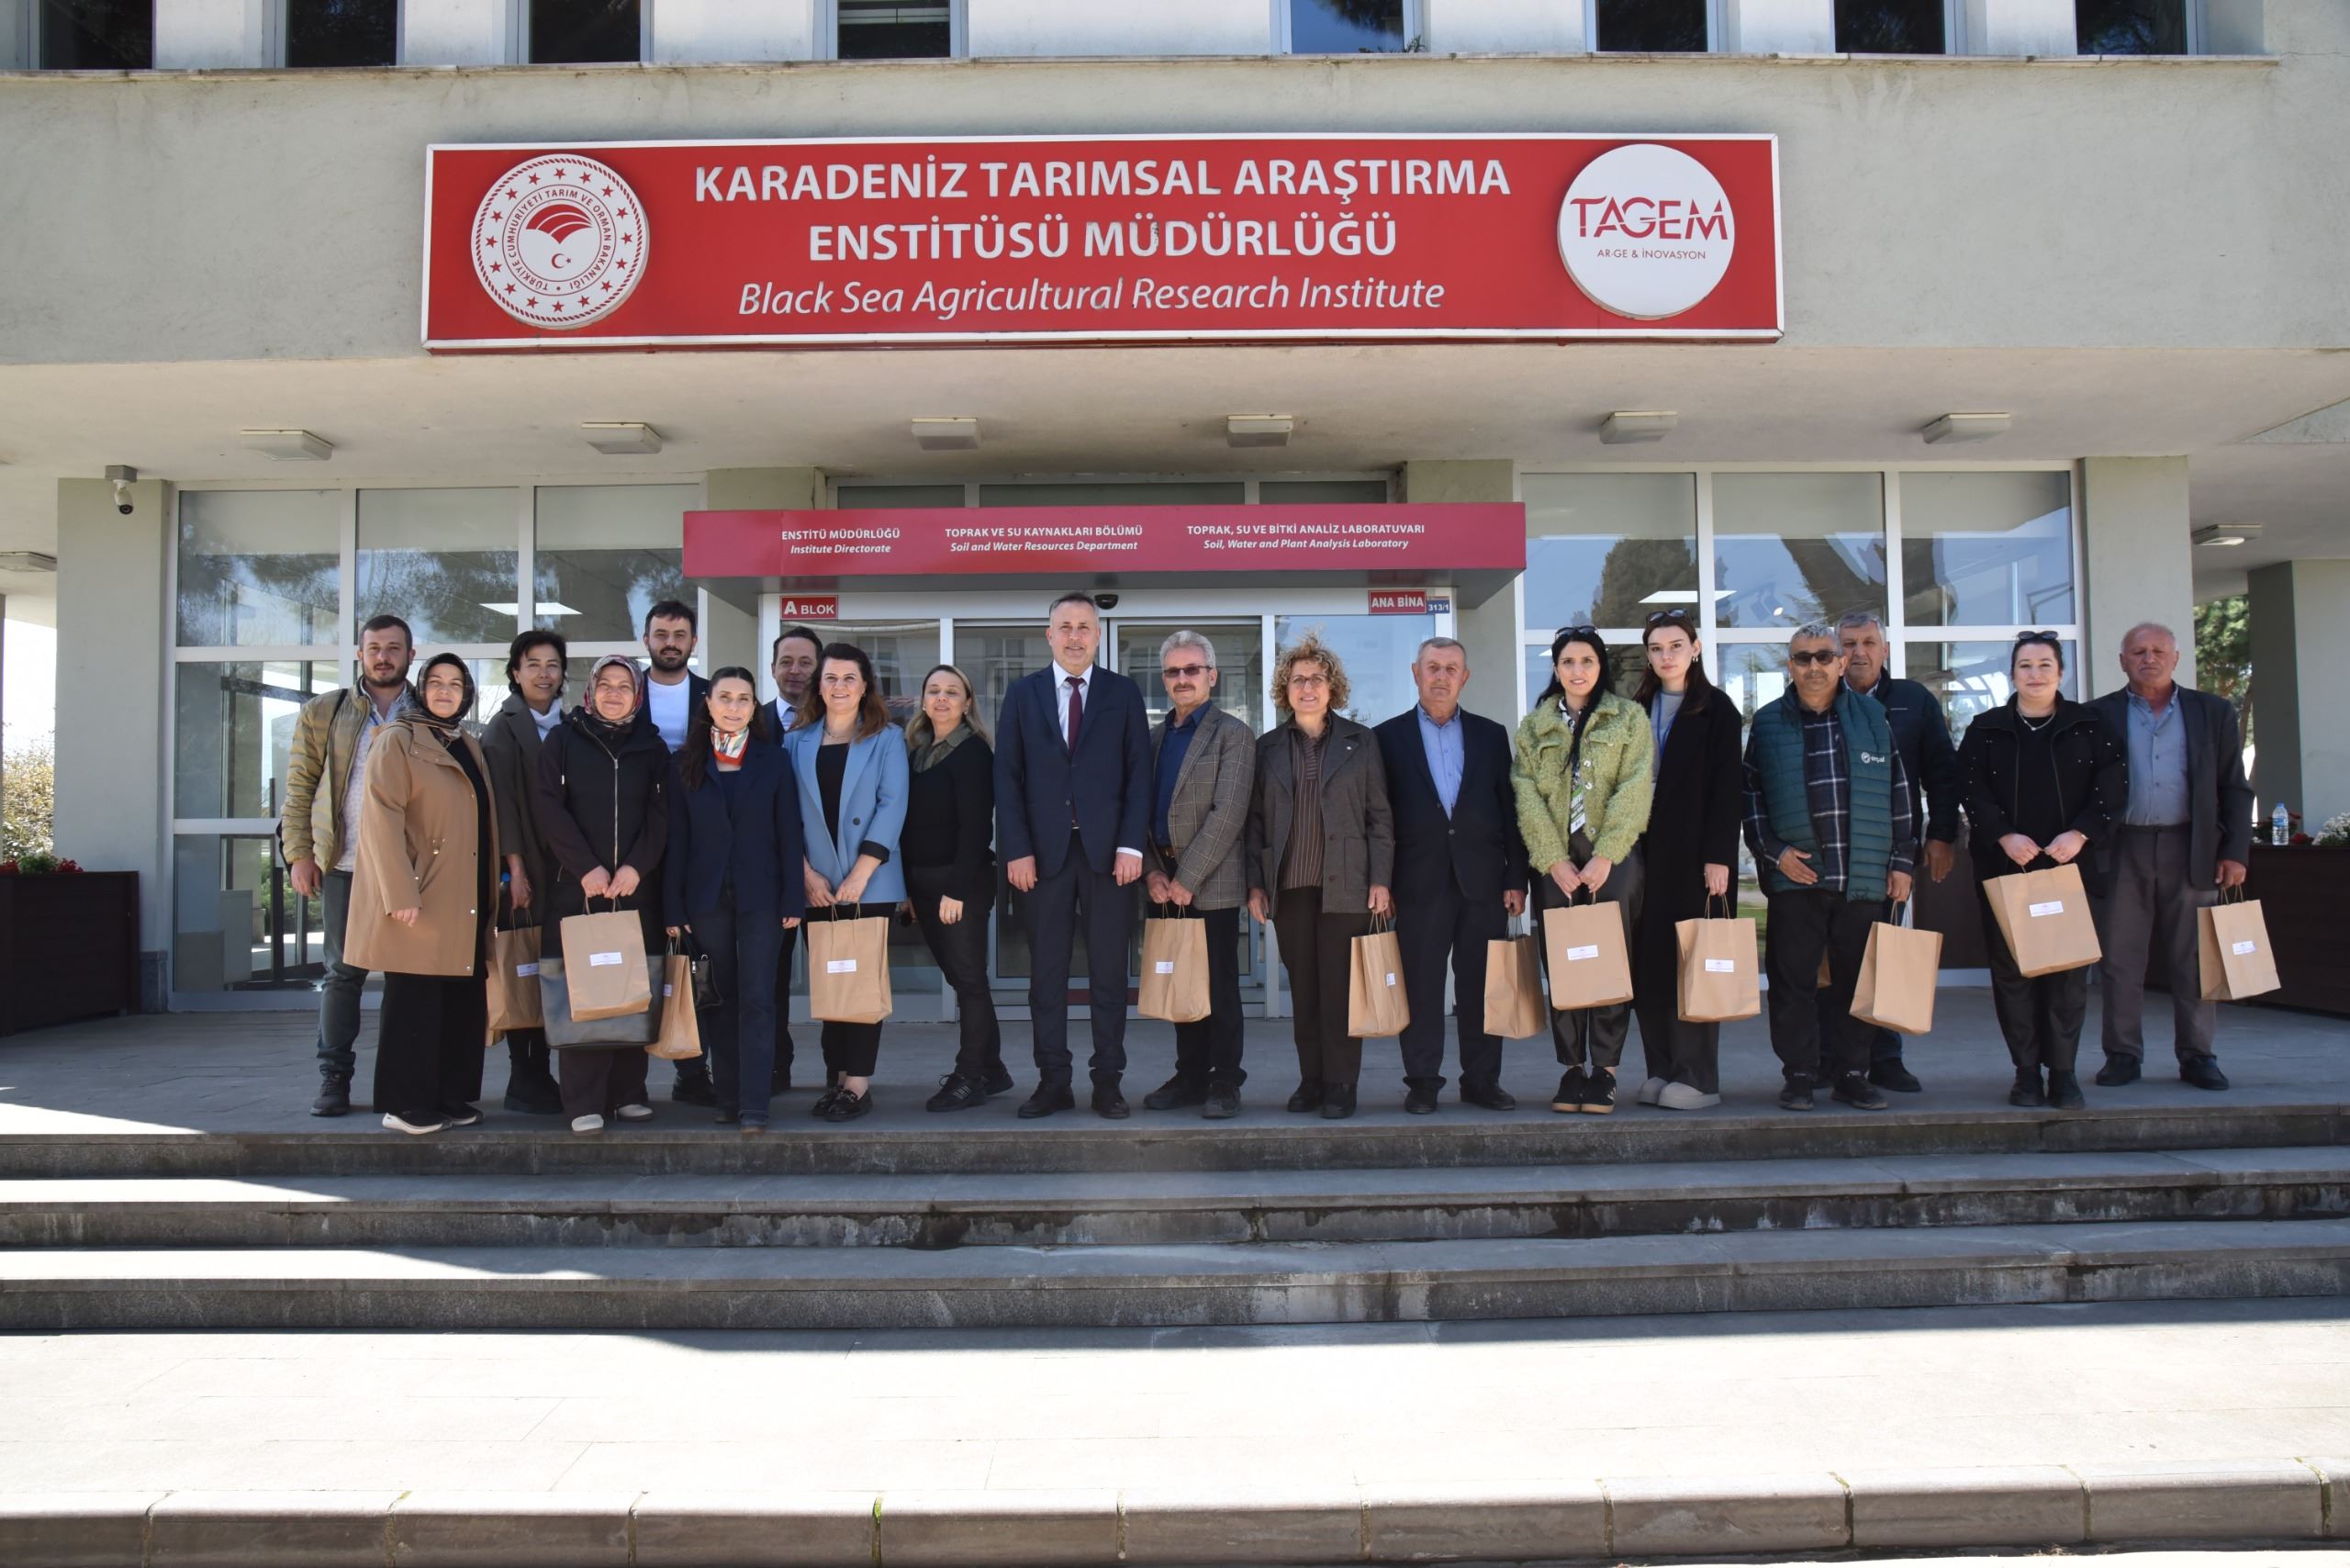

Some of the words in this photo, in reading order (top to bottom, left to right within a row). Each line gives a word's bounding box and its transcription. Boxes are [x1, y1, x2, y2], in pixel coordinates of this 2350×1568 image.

[695, 154, 968, 202] KARADENİZ
[979, 159, 1222, 198] TARIMSAL
[1233, 157, 1511, 205] ARAŞTIRMA
[545, 188, 577, 199] TARIM
[580, 194, 593, 206] VE
[508, 191, 543, 258] CUMHURİYETİ
[594, 206, 611, 241] ORMAN
[1570, 196, 1729, 241] TAGEM
[810, 213, 1069, 262] ENSTİTÜSÜ
[1084, 212, 1397, 258] MÜDÜRLÜĞÜ
[1631, 250, 1639, 258] &
[1641, 248, 1706, 259] İNOVASYON
[570, 245, 611, 290] BAKANLIĞI
[512, 261, 548, 291] TÜRKİYE
[739, 281, 834, 315] Black
[840, 281, 904, 313] Sea
[911, 277, 1123, 320] Agricultural
[1132, 275, 1290, 309] Research
[1300, 276, 1445, 308] Institute
[781, 528, 827, 541] ENSTİTÜ
[829, 527, 901, 540] MÜDÜRLÜĞÜ
[945, 528, 989, 538] TOPRAK
[990, 527, 1005, 537] VE
[1007, 527, 1022, 537] SU
[1024, 526, 1093, 537] KAYNAKLARI
[1095, 524, 1143, 536] BÖLÜMÜ
[1187, 525, 1234, 536] TOPRAK,
[1236, 525, 1251, 535] SU
[1252, 524, 1267, 534] VE
[1269, 522, 1297, 534] BİTKİ
[1299, 522, 1339, 534] ANALİZ
[1341, 523, 1425, 534] LABORATUVARI
[790, 545, 833, 554] Institute
[834, 543, 891, 554] Directorate
[950, 542, 969, 552] Soil
[971, 542, 991, 552] and
[992, 542, 1024, 551] Water
[1024, 541, 1074, 551] Resources
[1076, 540, 1138, 553] Department
[1203, 539, 1225, 551] Soil,
[1227, 539, 1258, 549] Water
[1259, 538, 1280, 548] and
[1281, 538, 1307, 548] Plant
[1309, 538, 1351, 551] Analysis
[1352, 538, 1409, 551] Laboratory
[784, 600, 798, 615] A
[800, 604, 834, 615] BLOK
[1371, 597, 1394, 608] ANA
[1397, 595, 1424, 608] BİNA
